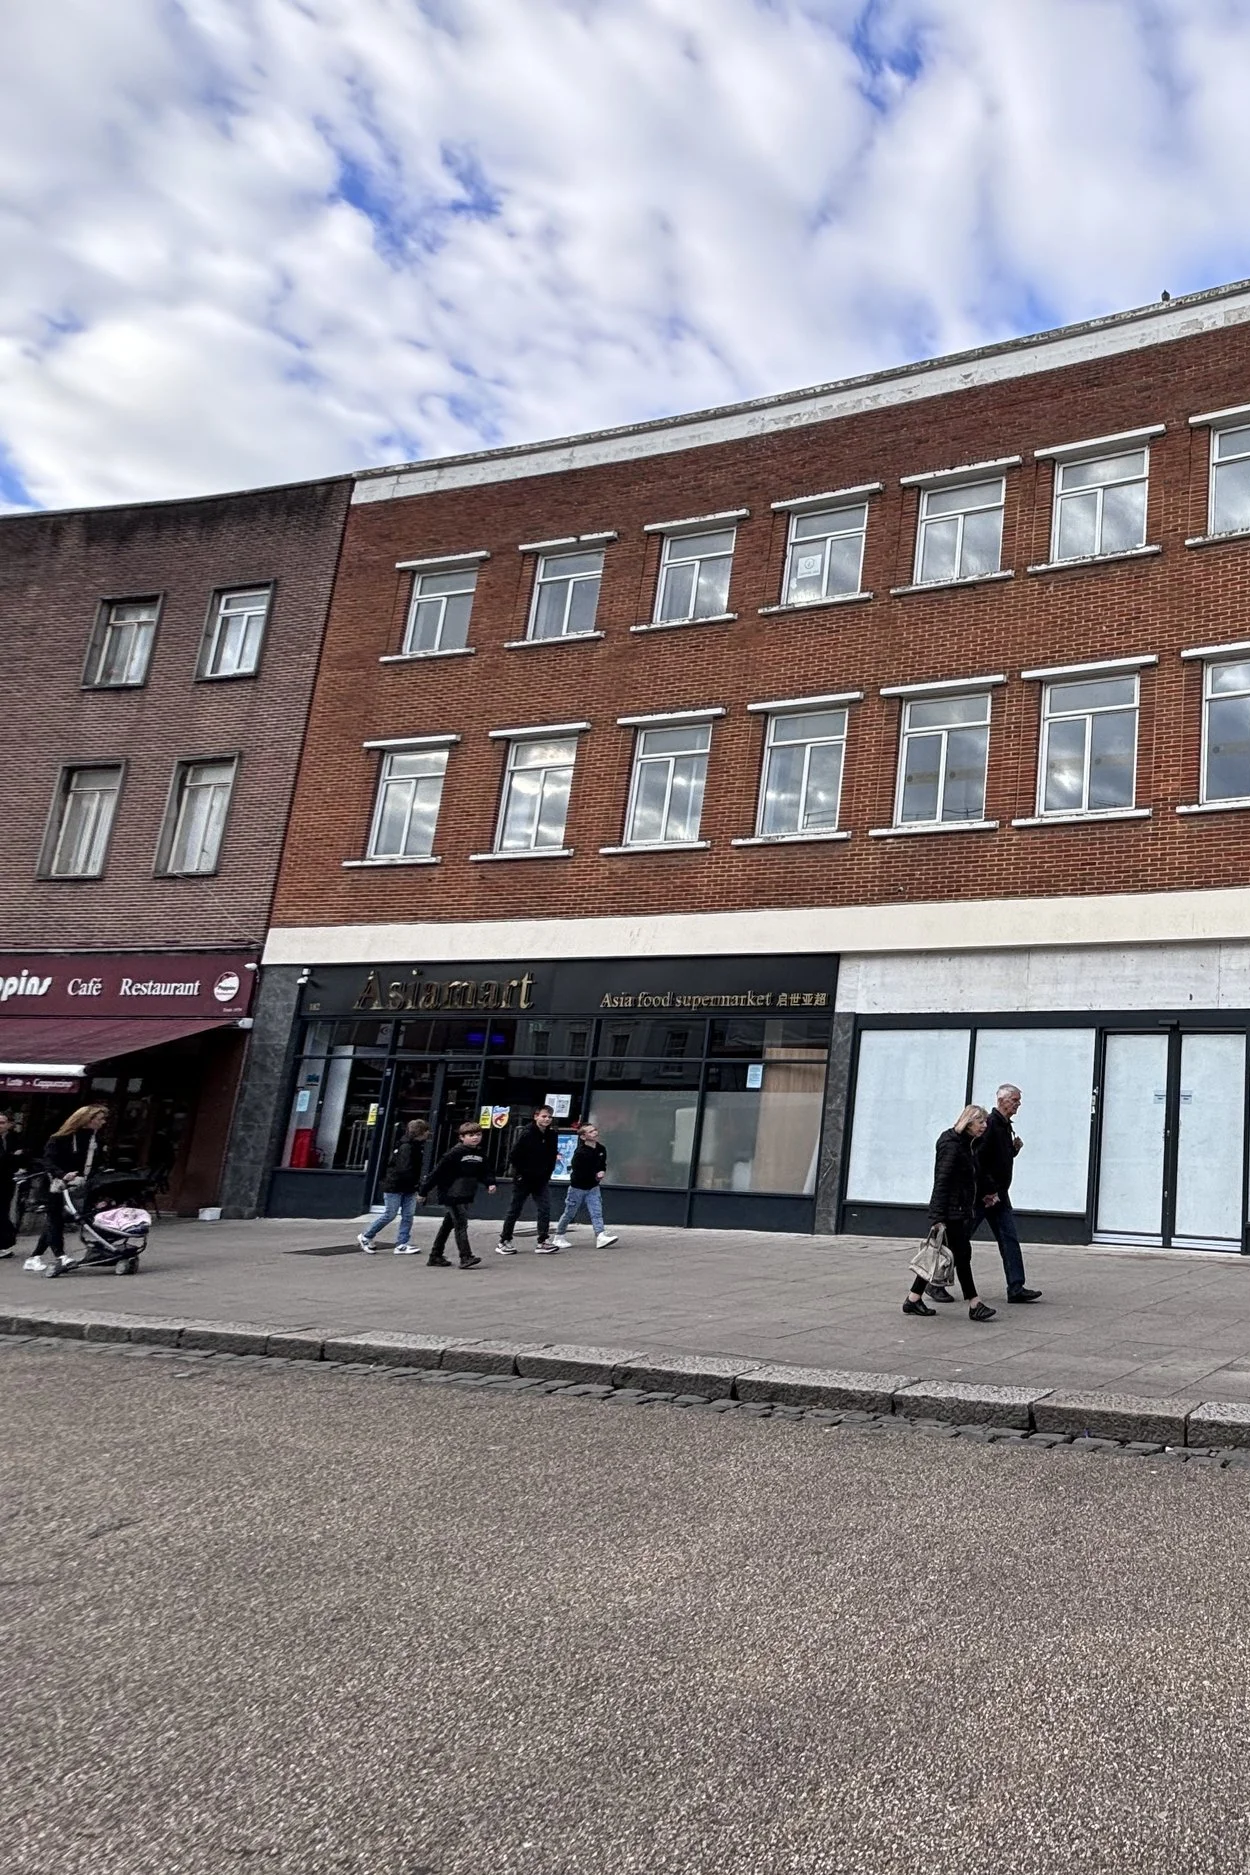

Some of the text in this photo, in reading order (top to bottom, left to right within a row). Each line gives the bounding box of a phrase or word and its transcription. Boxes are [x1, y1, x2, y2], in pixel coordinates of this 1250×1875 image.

[0, 969, 200, 1001] pins Café Restaurant
[352, 969, 534, 1010] Asiamart
[600, 989, 828, 1011] Asia food supermarket 启世亚超
